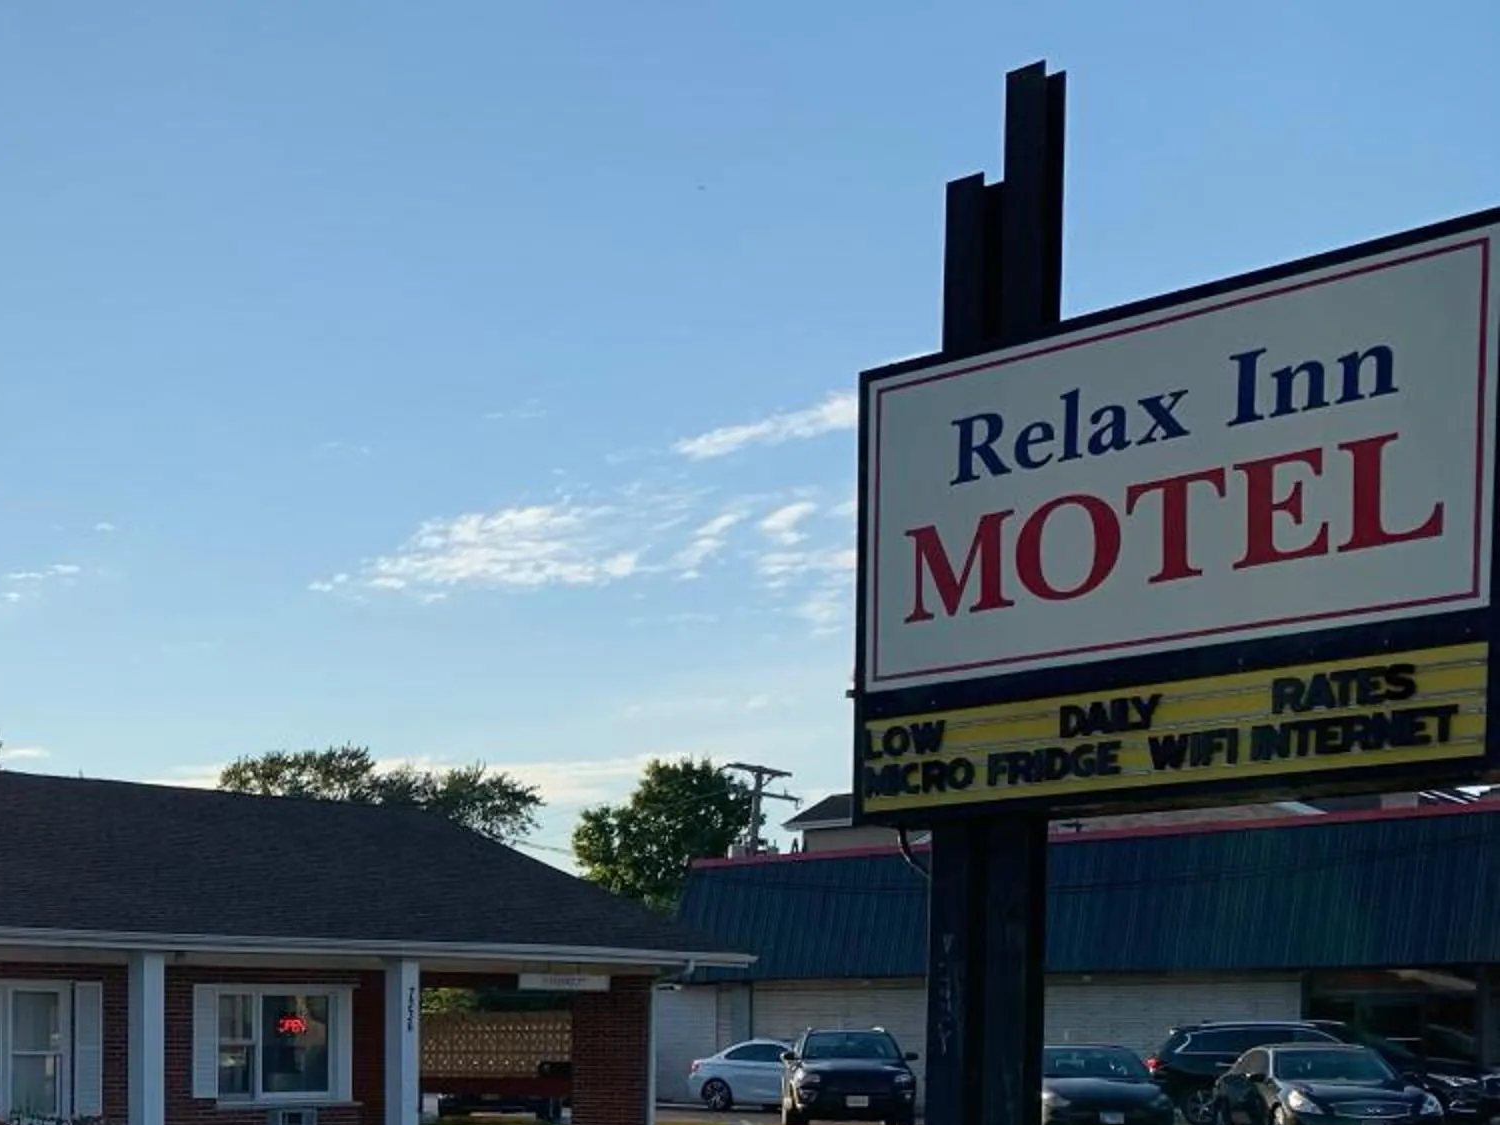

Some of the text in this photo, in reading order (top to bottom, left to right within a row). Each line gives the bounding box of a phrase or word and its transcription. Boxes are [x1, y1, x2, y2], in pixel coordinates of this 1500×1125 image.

[950, 341, 1399, 486] Relax Inn
[903, 431, 1445, 624] MOTEL
[864, 663, 1419, 760] LOW DAILY RATES
[864, 703, 1461, 799] MICRO FRIDGE WIFI INTERNET
